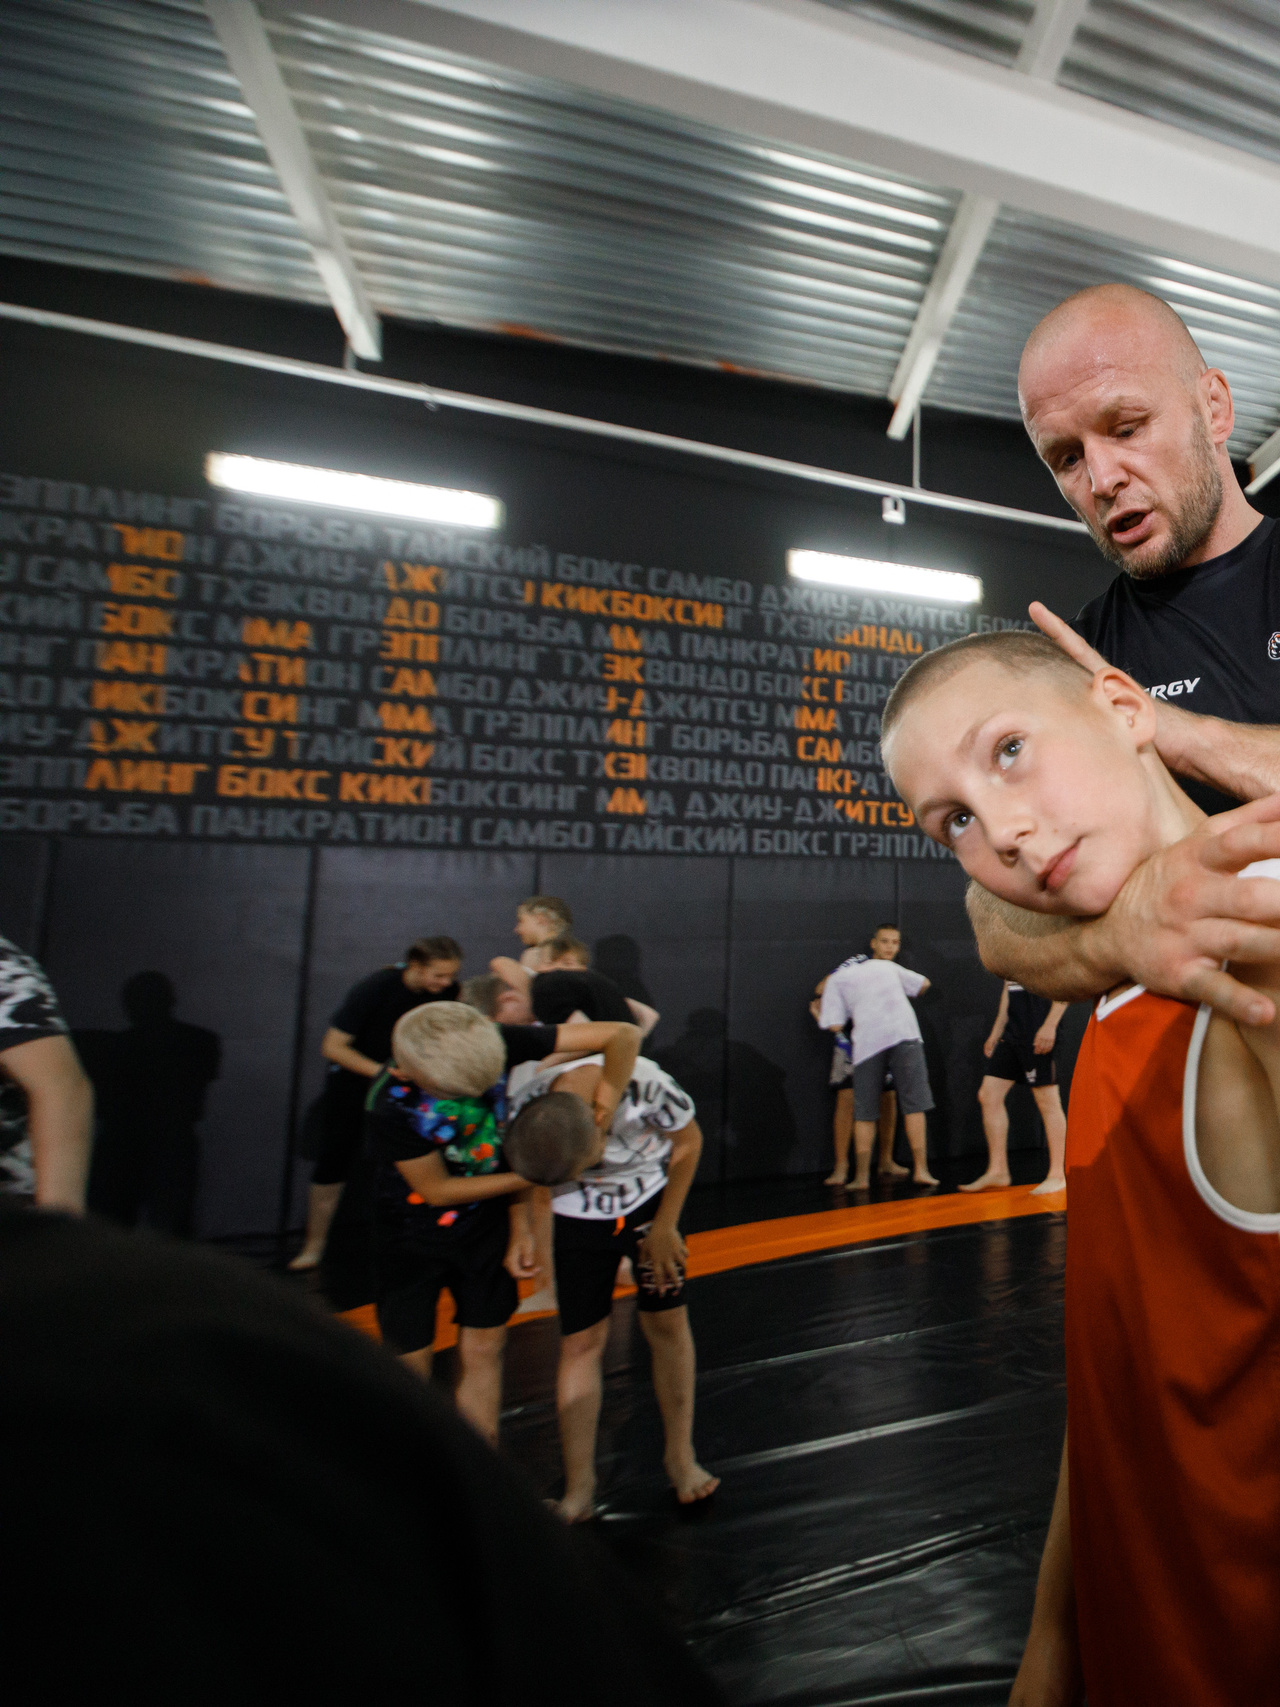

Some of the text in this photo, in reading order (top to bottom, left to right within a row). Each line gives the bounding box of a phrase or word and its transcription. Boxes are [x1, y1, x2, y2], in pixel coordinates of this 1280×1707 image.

[540, 580, 747, 634] КИКБОКСИНГ
[556, 551, 643, 592] БОКС
[647, 567, 752, 607] САМБО
[90, 600, 209, 642] БОКС
[327, 624, 549, 673] ГРЭППЛИНГ
[556, 648, 750, 696] ТХЭКВОНДО
[754, 671, 830, 704] БОКС
[445, 603, 586, 648] БОРЬБА
[590, 621, 674, 659] ММА
[680, 632, 868, 679] ПАНКРАТИОН
[60, 678, 351, 727] КИКБОКСИНГ
[357, 699, 453, 735] ММА
[460, 706, 664, 749] ГРЭППЛИНГ
[671, 723, 791, 758] БОРЬБА
[74, 639, 361, 694] ПАНКРАТИОН
[370, 664, 501, 703] САМБО
[504, 677, 768, 729] ДЖИУ-ДЖИТСУ
[773, 701, 843, 733] ММА
[1143, 677, 1201, 700] RGY
[282, 727, 466, 772] ТАЙСКИЙ
[471, 742, 564, 778] БОКС
[572, 748, 765, 791] ТХЭКВОНДО
[0, 797, 179, 836] БОРЬБА
[189, 803, 462, 844] ПАНКРАТИОН
[469, 819, 596, 850] САМБО
[601, 818, 749, 855] ТАЙСКИЙ
[754, 828, 828, 857] БОКС
[216, 763, 333, 802] БОКС
[338, 770, 589, 814] КИКБОКСИНГ
[594, 785, 677, 817] ММА
[684, 791, 916, 828] ДЖИУ-ДЖИТСУ
